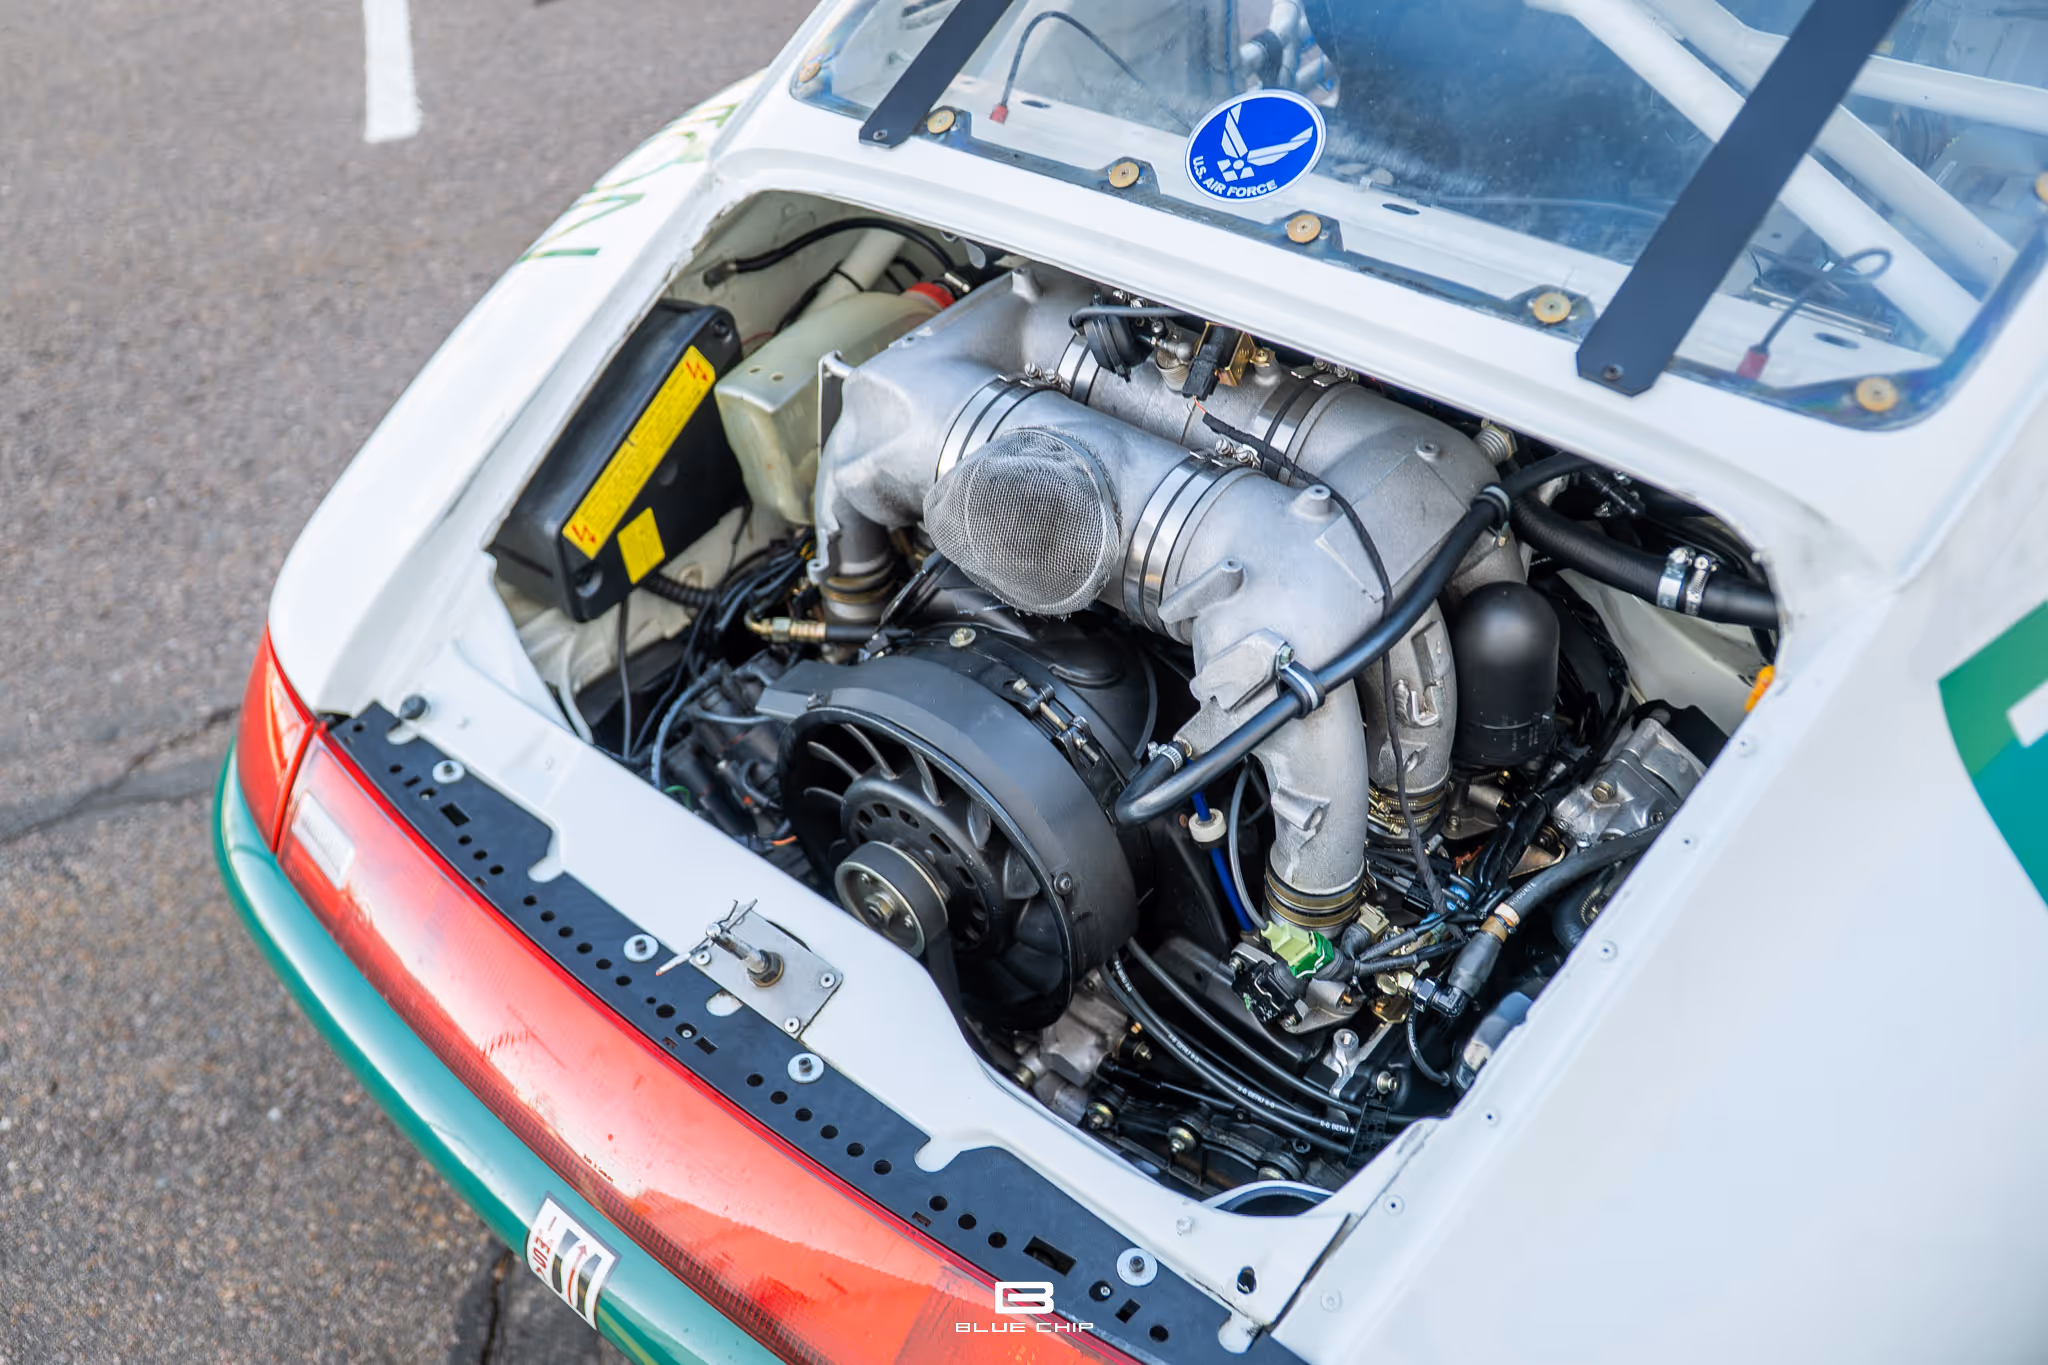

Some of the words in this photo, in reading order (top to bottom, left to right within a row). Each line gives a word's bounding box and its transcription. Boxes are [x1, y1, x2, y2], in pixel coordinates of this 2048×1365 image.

[1192, 155, 1207, 181] U.S.
[1203, 175, 1226, 195] AIR
[1226, 179, 1278, 198] FORCE
